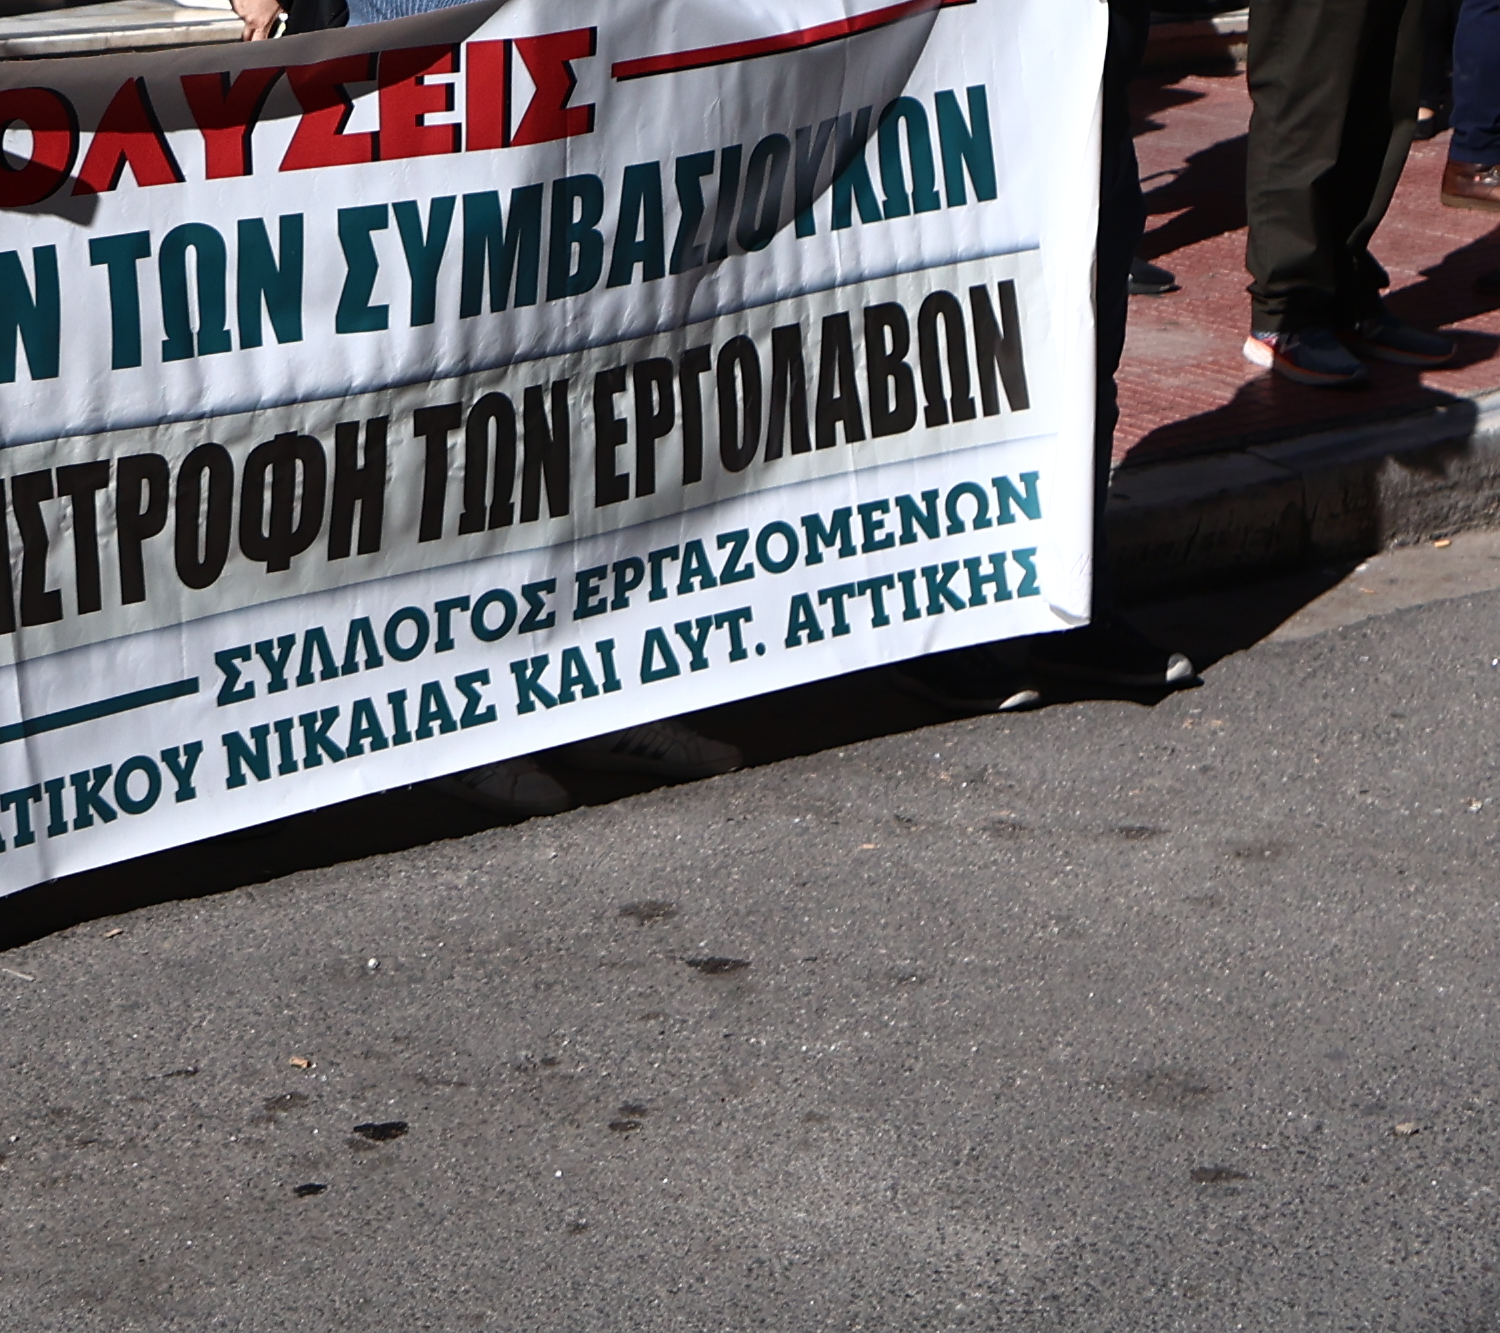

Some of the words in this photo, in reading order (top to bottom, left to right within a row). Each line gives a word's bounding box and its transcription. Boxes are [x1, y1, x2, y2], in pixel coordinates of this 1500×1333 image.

[90, 213, 305, 370] ΤΩΝ
[413, 378, 570, 544] ΤΩΝ
[593, 279, 1031, 508] ΕΡΓΟΛΑΒΩΝ
[214, 577, 557, 709] ΣΥΛΛΟΓΟΣ
[573, 469, 1044, 623] ΕΡΓΑΖΟΜΕΝΩΝ
[223, 667, 498, 793] ΝΙΚΑΙΑΣ
[510, 639, 622, 717] ΚΑΙ
[639, 605, 768, 685] ΔΥΤ.
[784, 547, 1042, 648] ΑΤΤΙΚΗΣ
